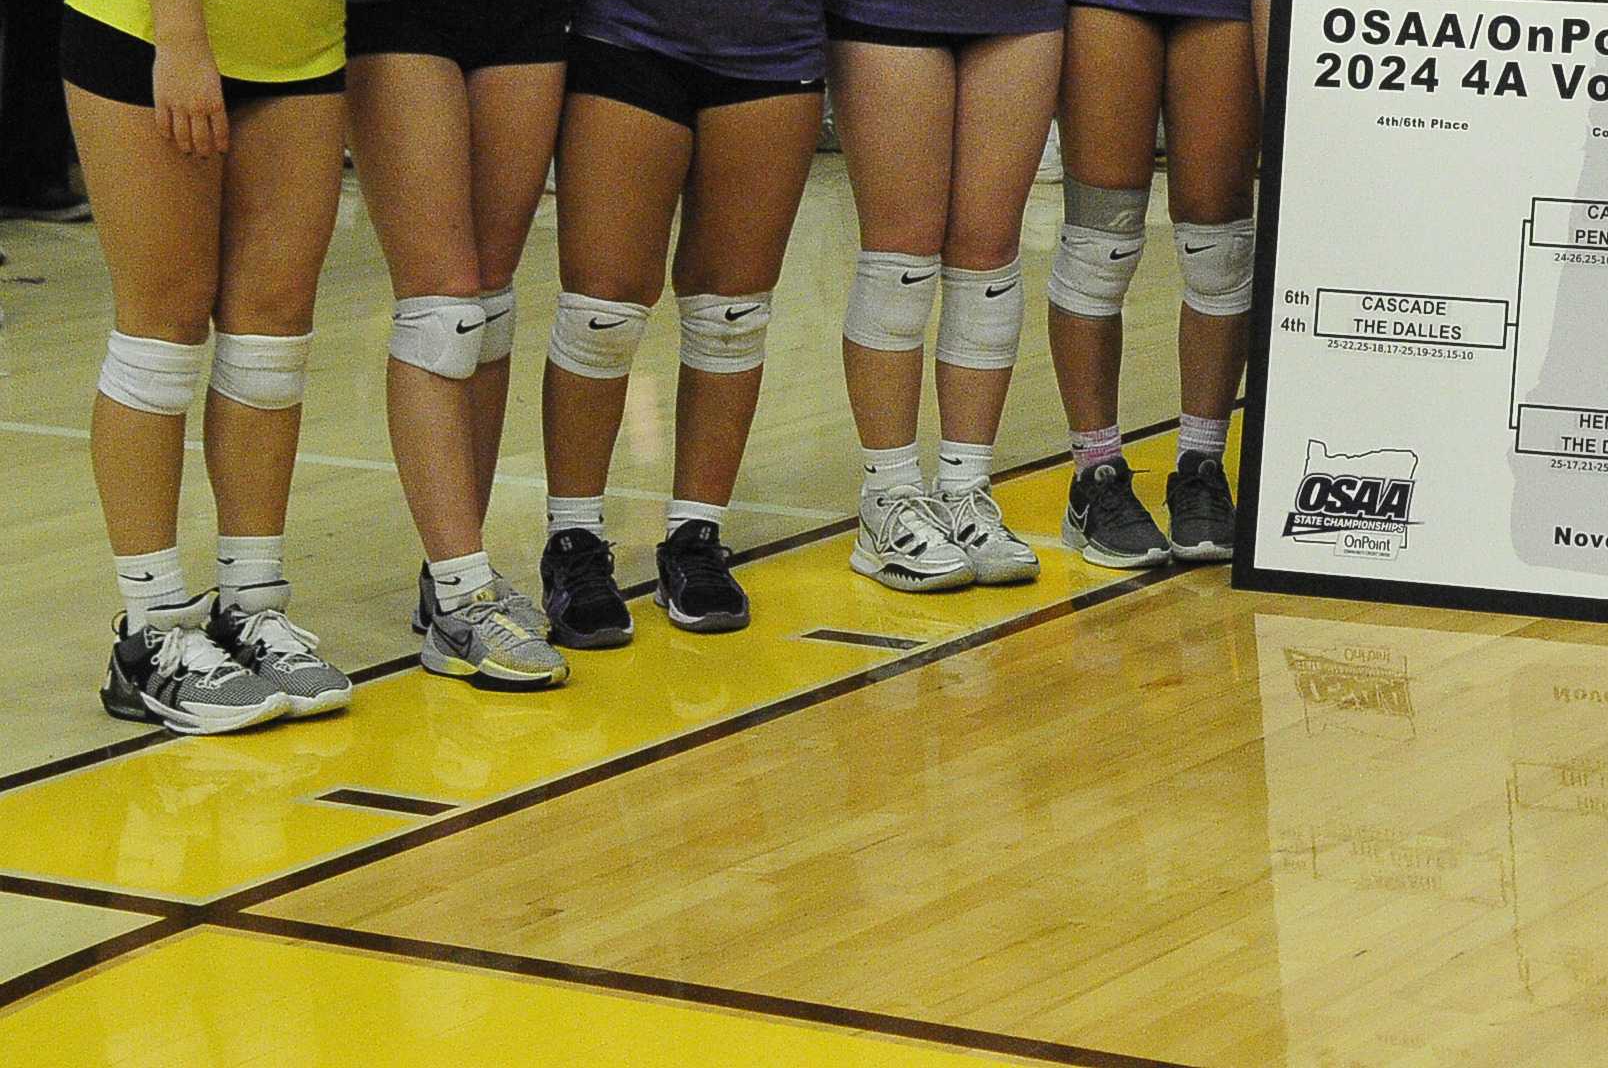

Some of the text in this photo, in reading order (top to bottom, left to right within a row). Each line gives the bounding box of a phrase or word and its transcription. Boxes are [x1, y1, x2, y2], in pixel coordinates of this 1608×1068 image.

[1314, 53, 1438, 92] 2024
[1462, 60, 1527, 97] 4A
[1377, 116, 1468, 130] 4th/6th Place
[1285, 290, 1309, 305] 6th
[1362, 296, 1446, 316] CASCADE
[1281, 317, 1305, 332] 4th
[1353, 319, 1461, 340] THE DALLES
[1328, 340, 1473, 360] 25-22,25-18,17-25,19-25,15-10
[1561, 436, 1596, 453] THE
[1296, 474, 1414, 521] OSAA
[1294, 515, 1405, 533] STATE CHAMPIONSHIPS
[1344, 535, 1390, 554] OnPoint
